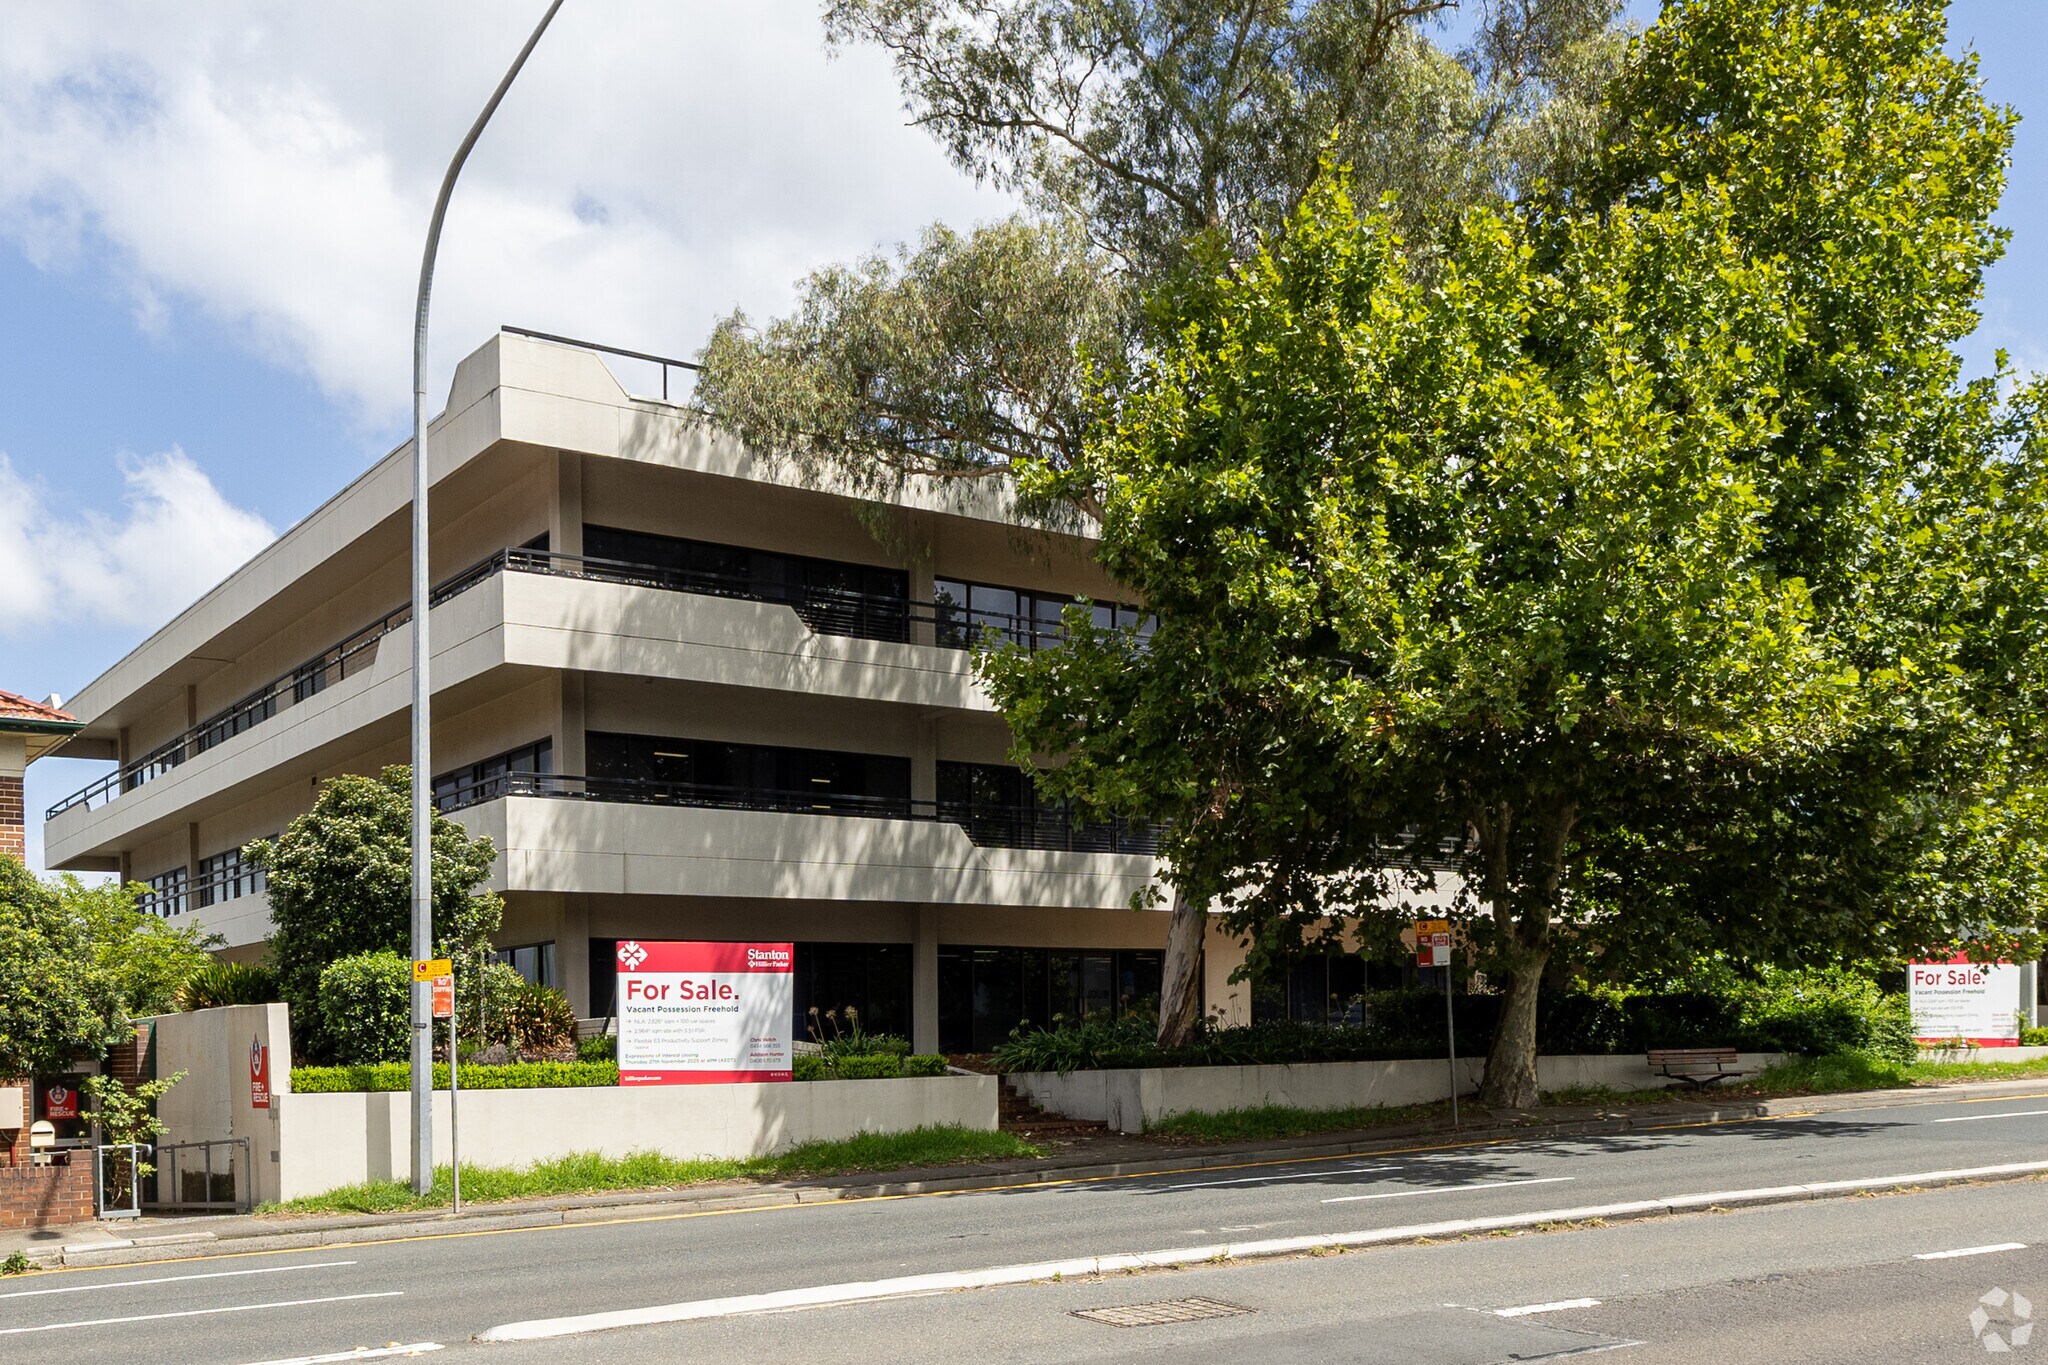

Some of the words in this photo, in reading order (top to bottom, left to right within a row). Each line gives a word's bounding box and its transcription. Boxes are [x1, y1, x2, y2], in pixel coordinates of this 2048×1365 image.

[748, 949, 789, 960] Stanton
[419, 964, 425, 972] C
[1915, 970, 1942, 985] For
[1948, 970, 1985, 985] Sale.
[627, 980, 670, 1000] For
[680, 979, 740, 1000] Sale.
[253, 1092, 268, 1102] RESCUE
